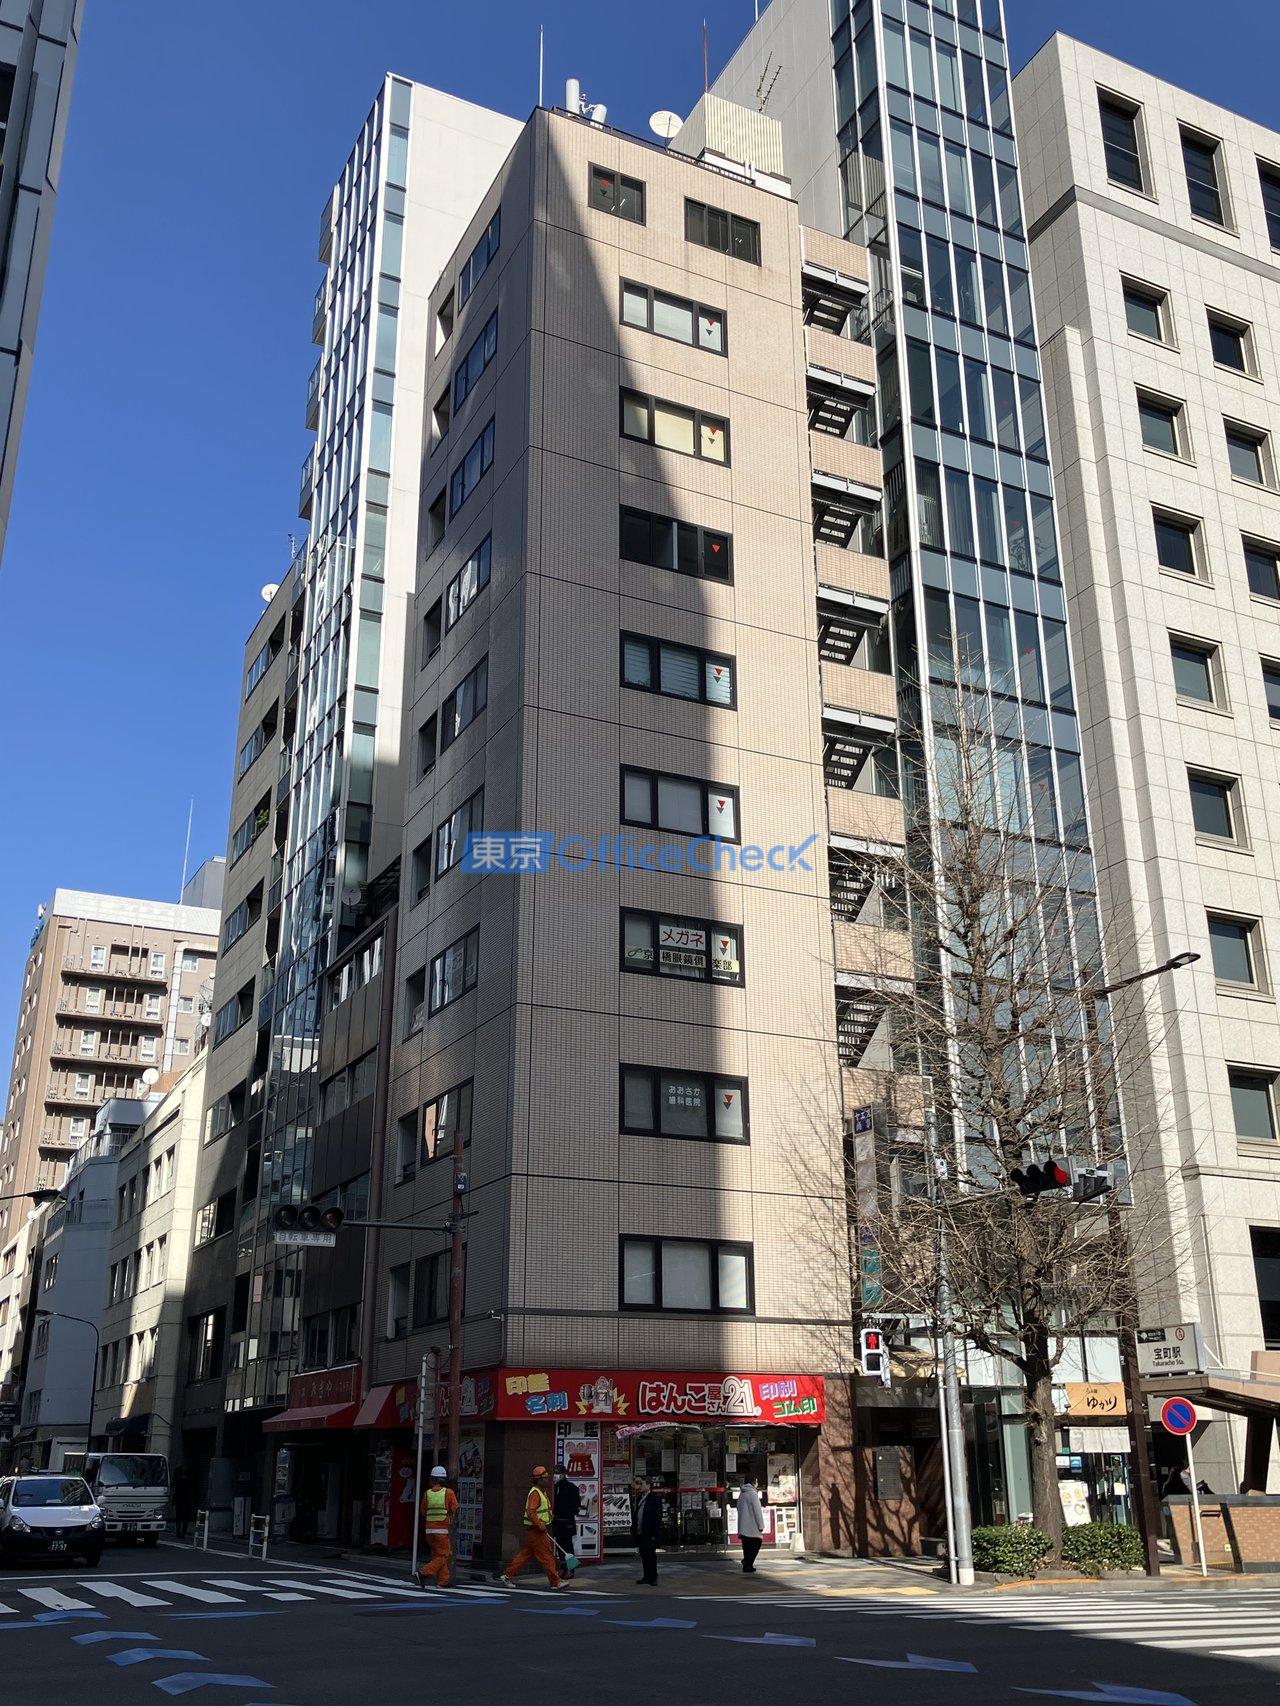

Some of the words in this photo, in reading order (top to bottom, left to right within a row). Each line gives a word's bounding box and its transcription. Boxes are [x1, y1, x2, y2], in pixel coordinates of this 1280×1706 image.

[662, 928, 704, 947] メガネ
[1153, 1346, 1182, 1360] 宝町駅
[760, 1380, 797, 1400] 印刷
[525, 1391, 568, 1414] 名刺
[1086, 1395, 1117, 1412] ゆかり
